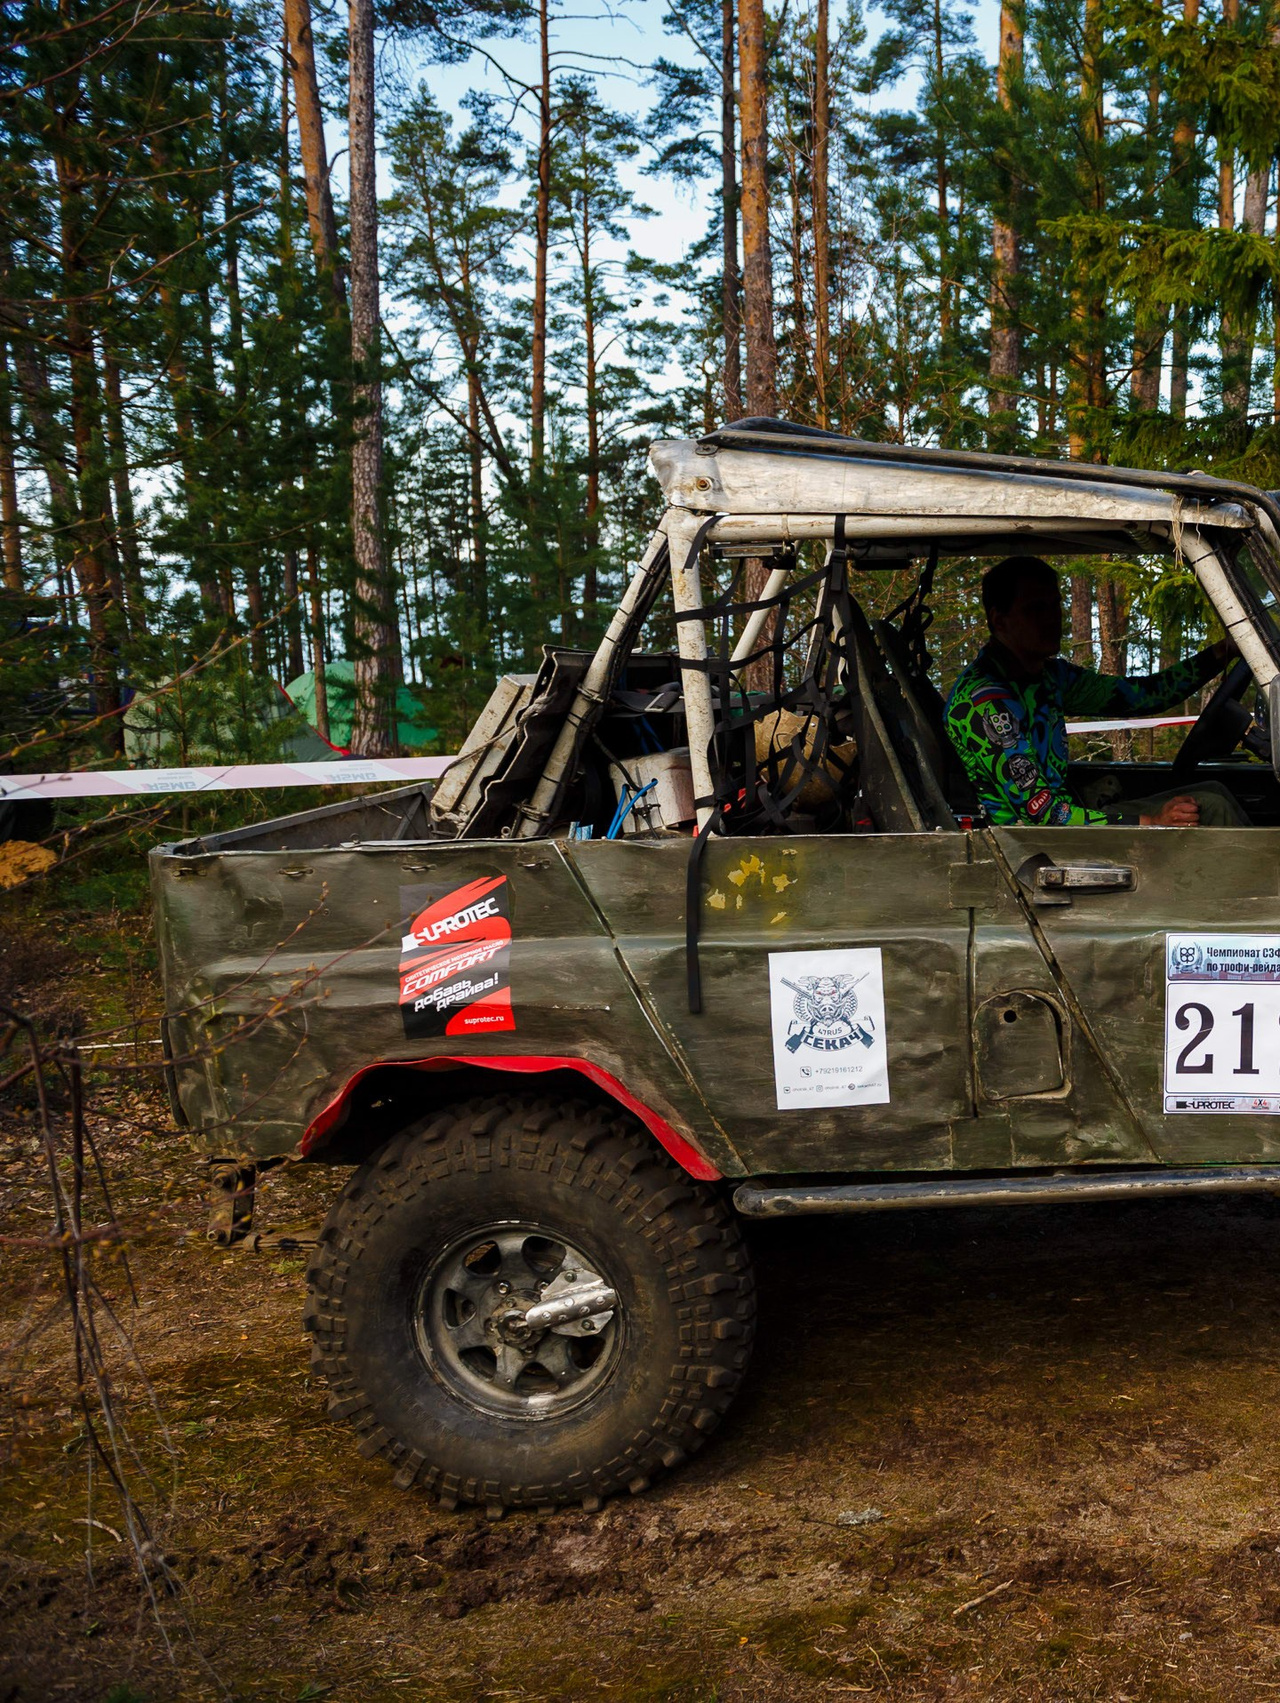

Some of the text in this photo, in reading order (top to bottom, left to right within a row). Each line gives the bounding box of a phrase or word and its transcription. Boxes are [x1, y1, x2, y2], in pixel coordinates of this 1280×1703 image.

[403, 897, 500, 949] SUPROTEC
[1206, 947, 1260, 958] Чемпионат
[403, 946, 502, 996] COMFORT
[1206, 963, 1218, 972] по
[464, 1016, 505, 1025] suprotec.ru
[818, 1027, 843, 1036] 47RUS
[803, 1031, 861, 1050] СЕКАЧ
[1177, 1101, 1235, 1109] SUPROTEC
